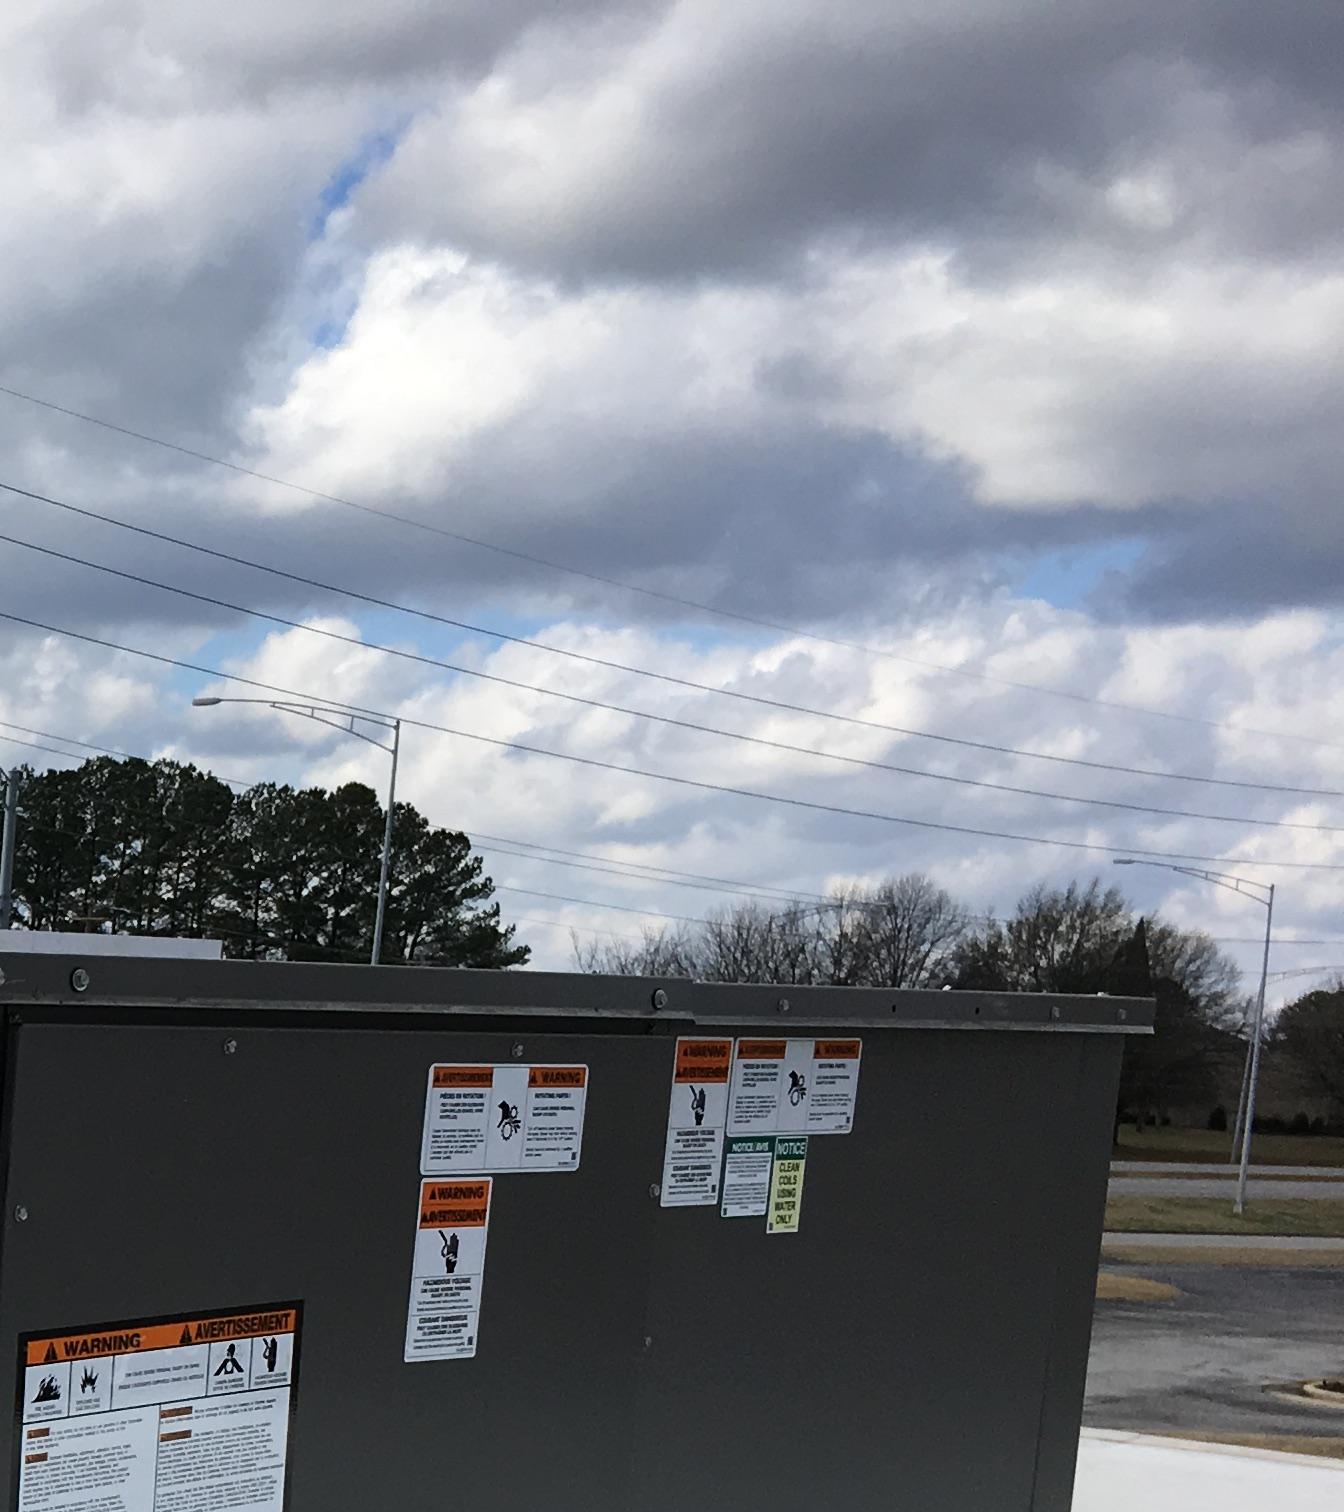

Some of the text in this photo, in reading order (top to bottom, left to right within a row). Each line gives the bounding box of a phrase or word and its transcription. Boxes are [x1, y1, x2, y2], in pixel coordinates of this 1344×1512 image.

[542, 1072, 581, 1083] WARNING
[777, 1142, 806, 1155] NOTICE
[779, 1162, 800, 1172] CLEAN
[778, 1175, 798, 1185] COILS
[437, 1186, 484, 1199] WARNING
[777, 1189, 796, 1198] USING
[775, 1201, 795, 1211] WATER
[775, 1214, 793, 1225] ONLY
[195, 1313, 291, 1340] AVERTISSEMENT
[64, 1333, 141, 1357] WARNING
